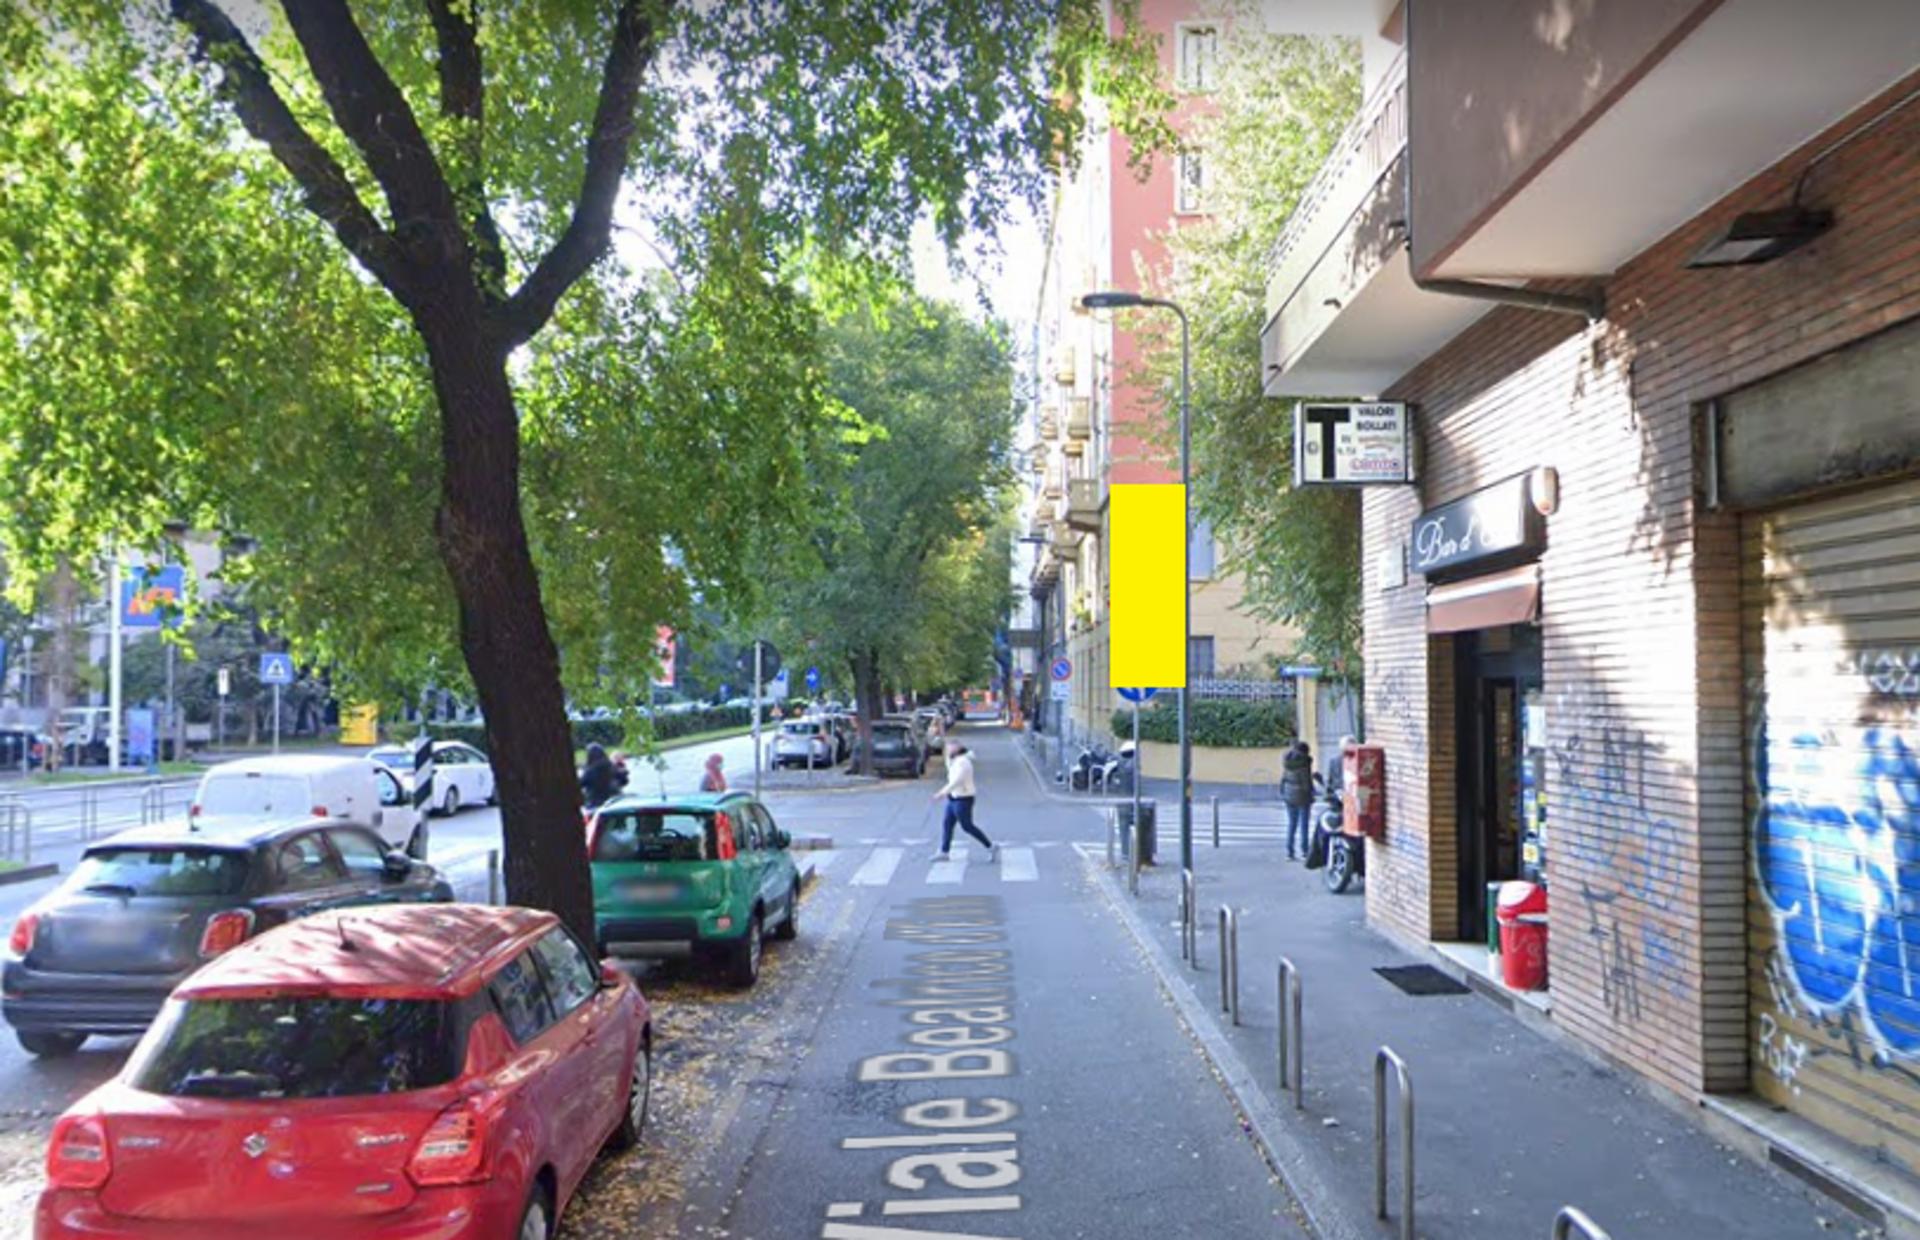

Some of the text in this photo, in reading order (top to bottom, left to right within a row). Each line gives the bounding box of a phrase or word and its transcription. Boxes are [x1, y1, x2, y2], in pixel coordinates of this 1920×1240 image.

[1358, 406, 1395, 416] VALORI
[1356, 421, 1397, 431] BOLLATI
[1307, 407, 1350, 478] T
